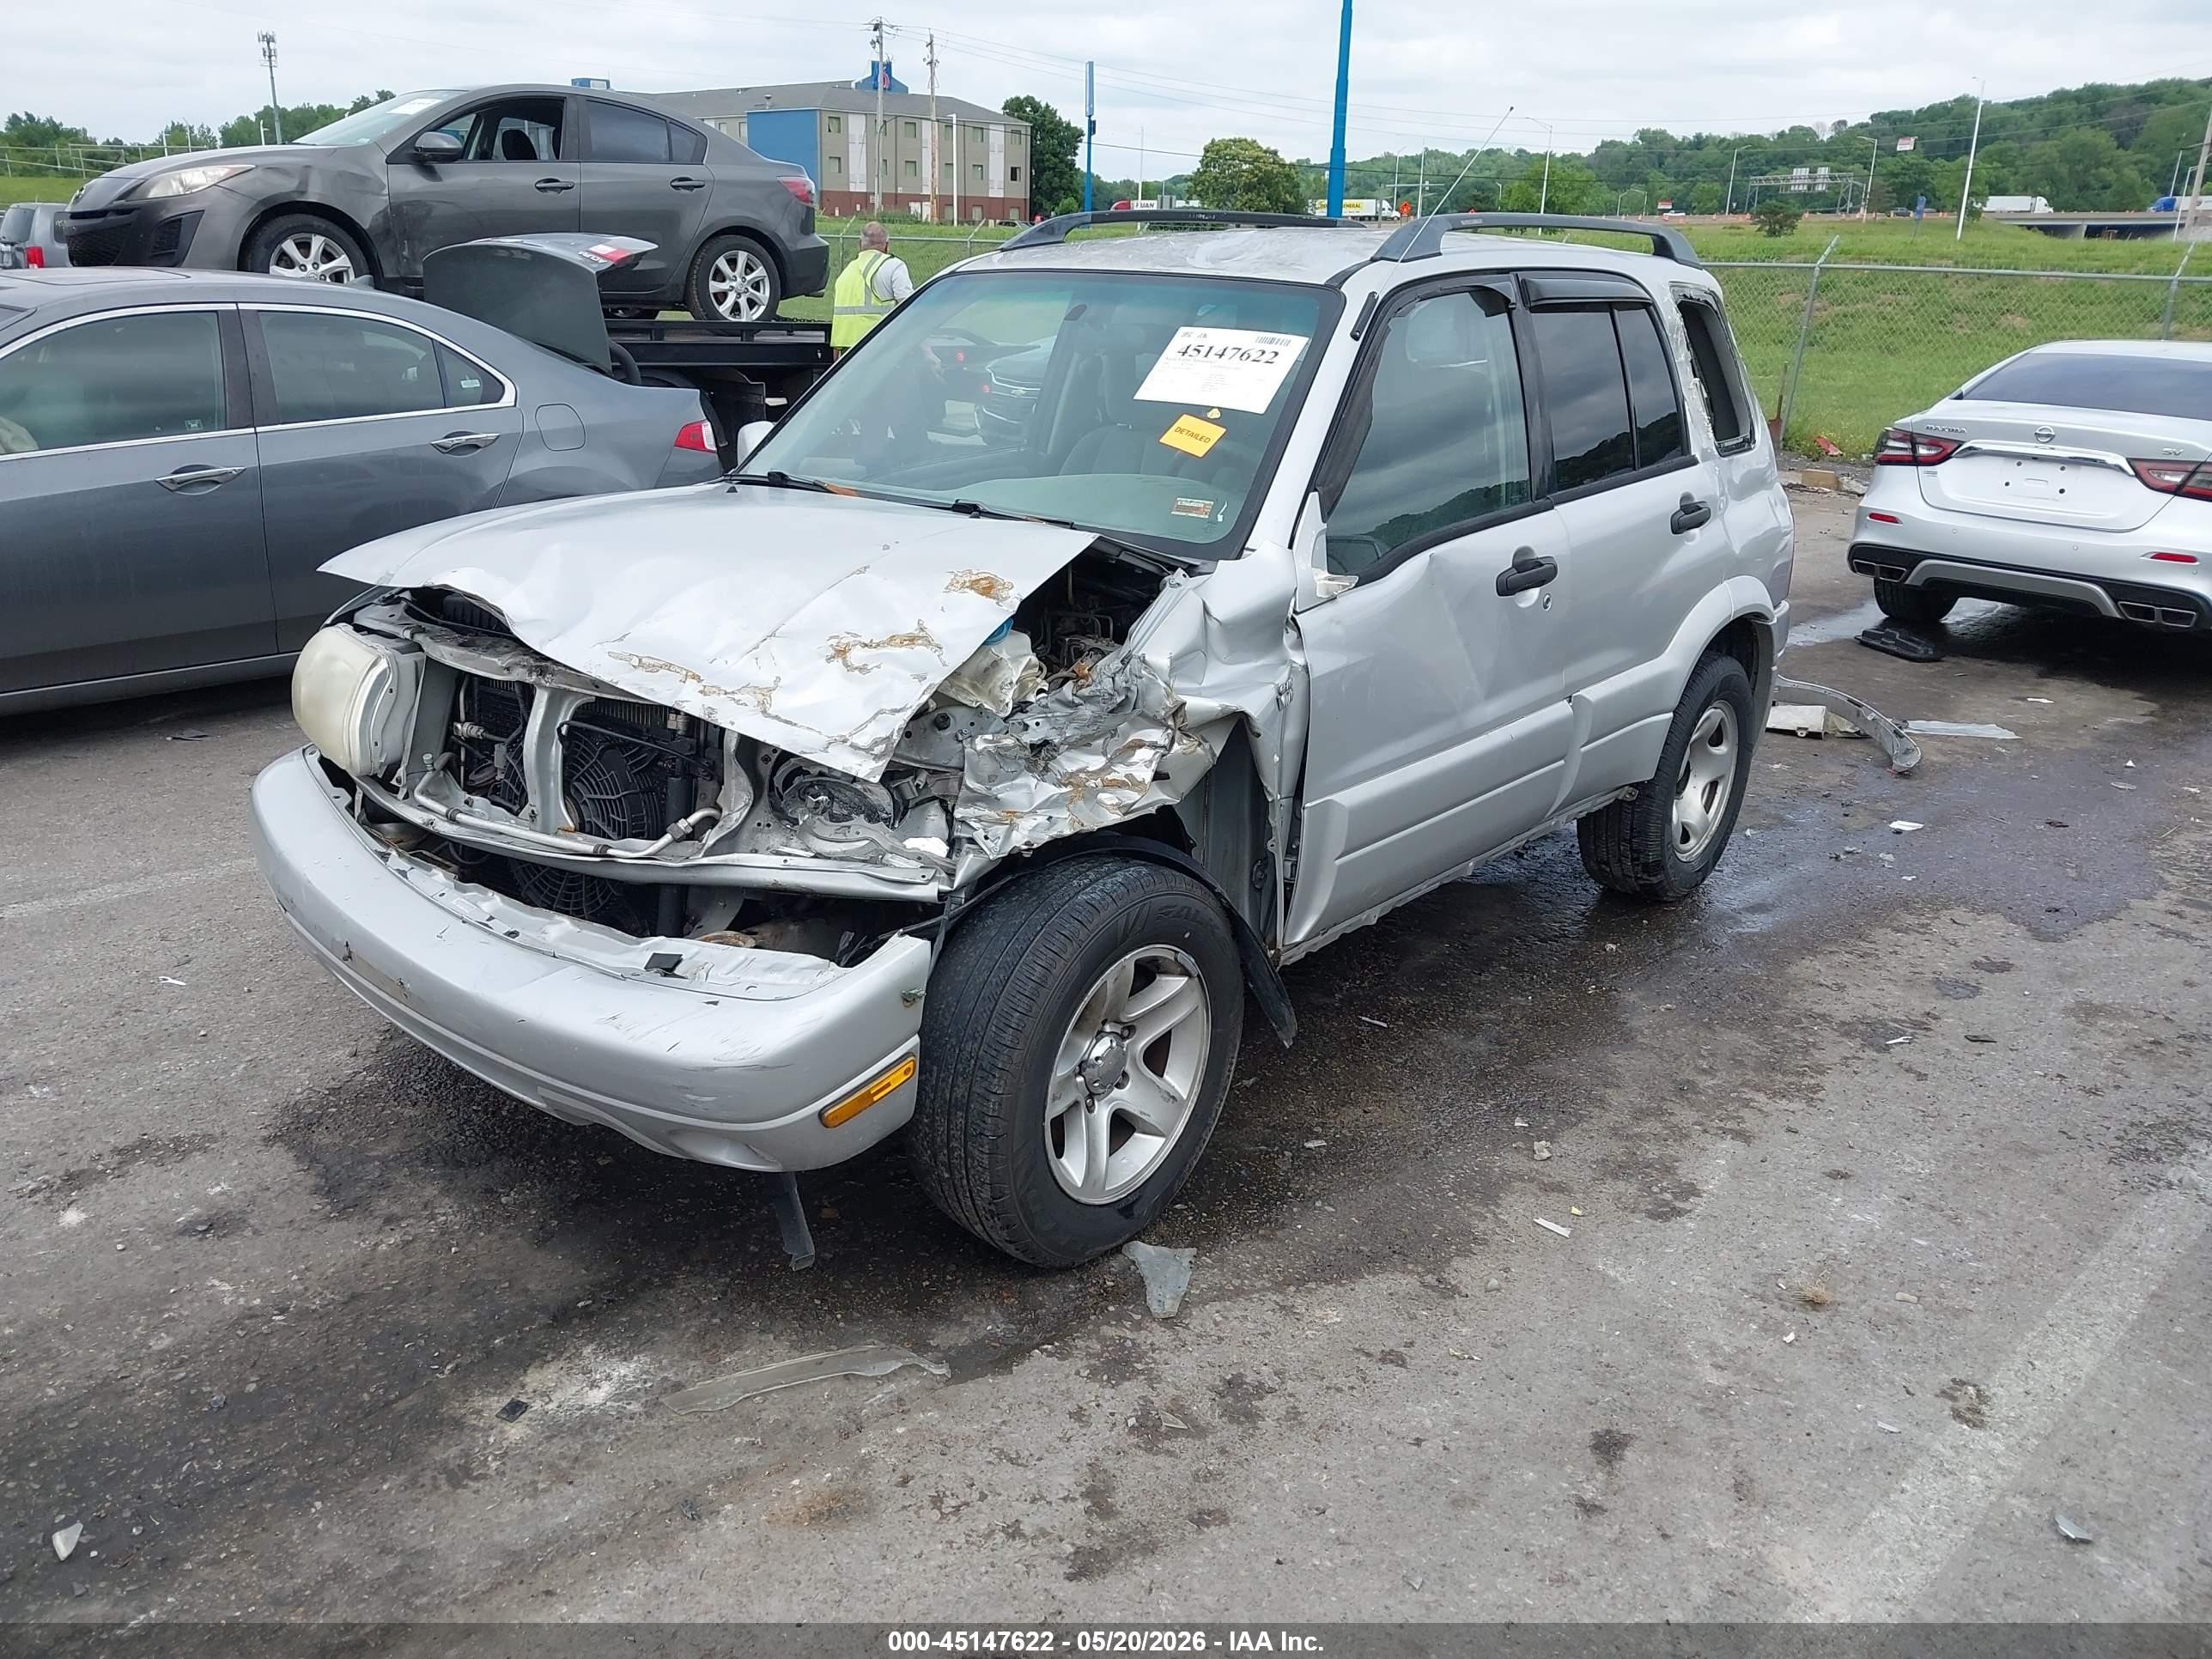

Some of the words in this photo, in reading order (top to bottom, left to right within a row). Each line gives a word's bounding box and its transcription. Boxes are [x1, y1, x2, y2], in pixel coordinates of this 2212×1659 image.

[1177, 343, 1279, 364] 45147622
[1174, 426, 1211, 443] DETAILED
[2161, 447, 2185, 456] SV
